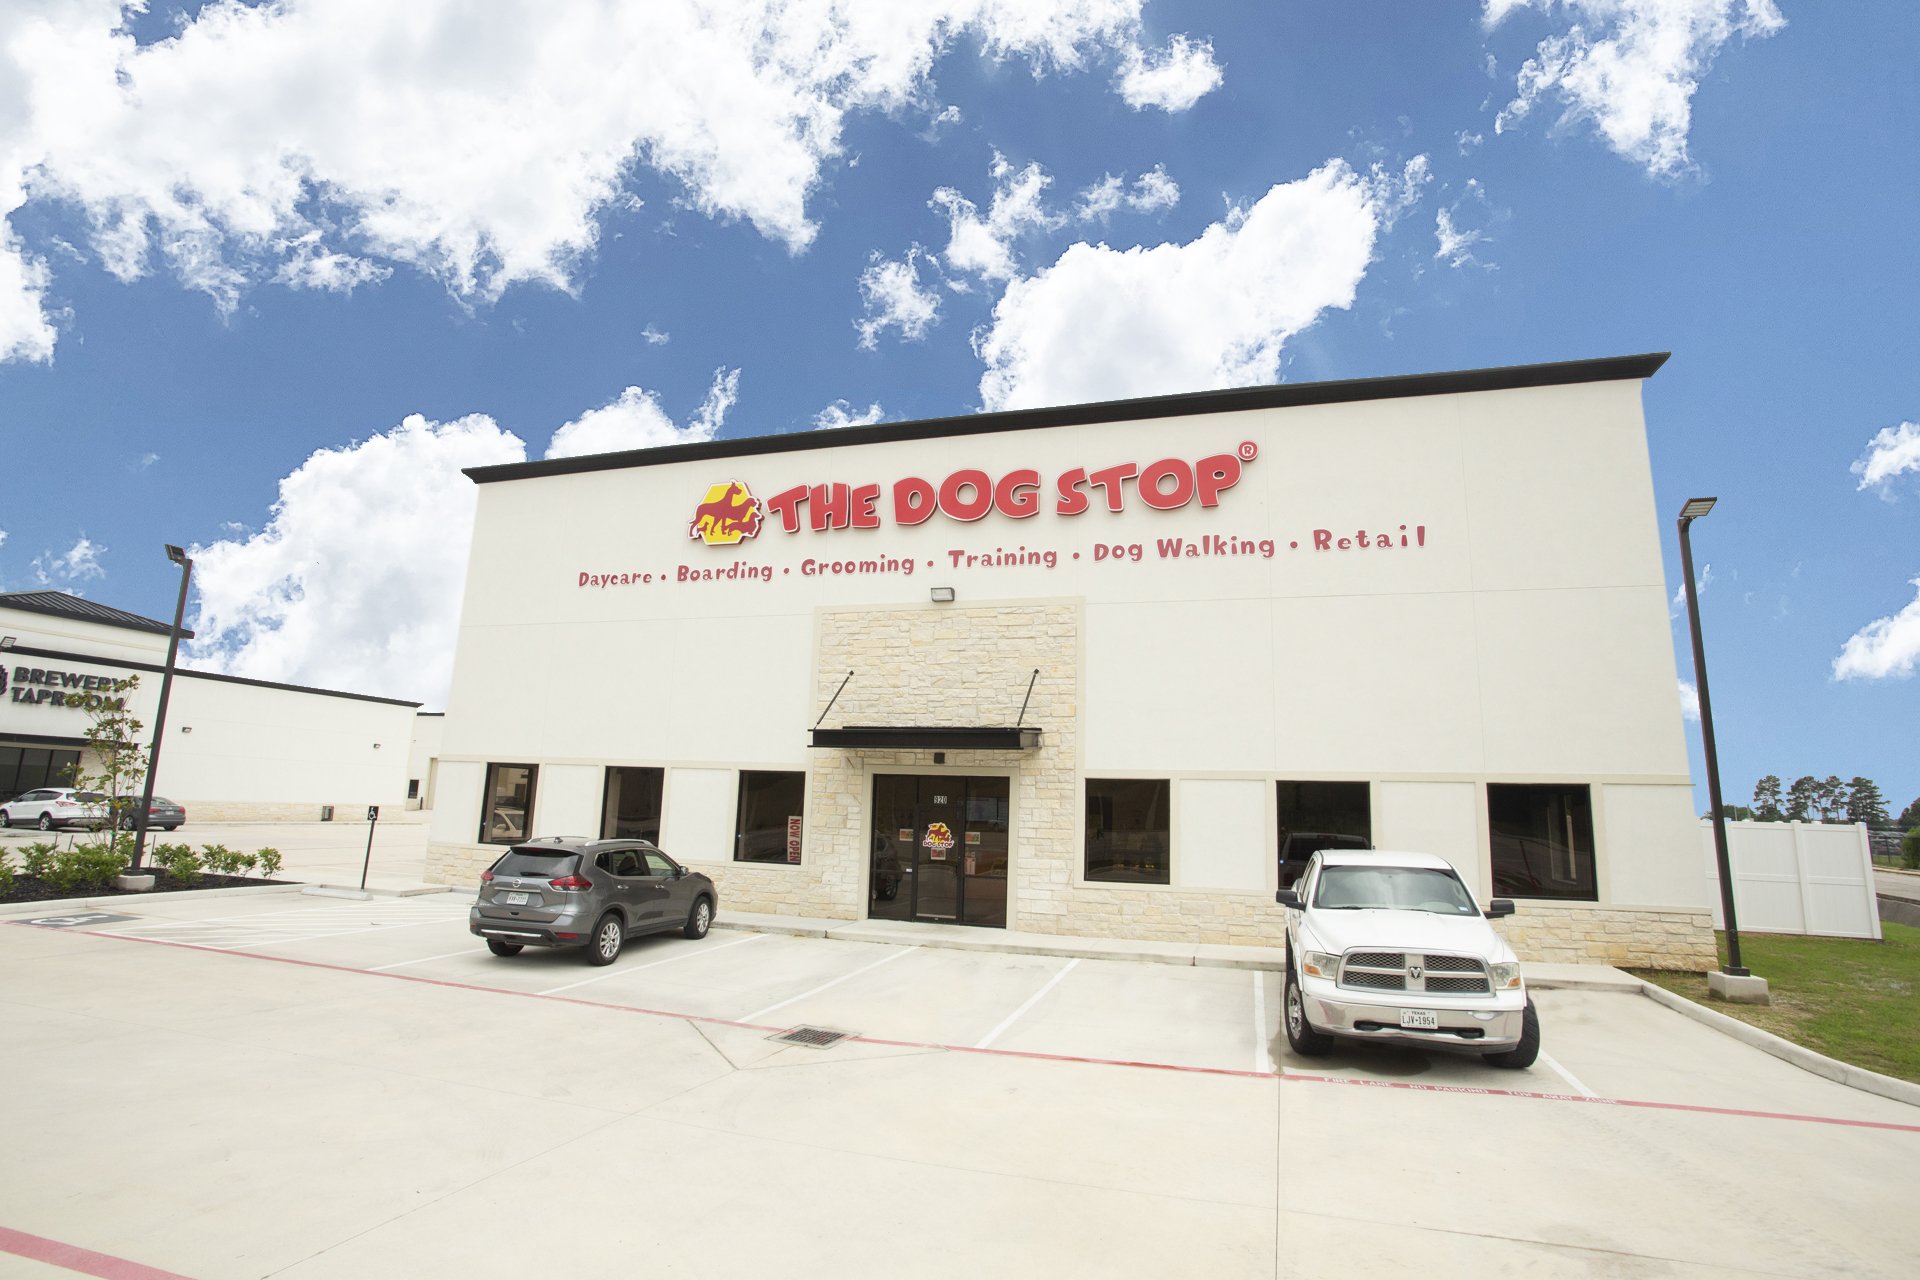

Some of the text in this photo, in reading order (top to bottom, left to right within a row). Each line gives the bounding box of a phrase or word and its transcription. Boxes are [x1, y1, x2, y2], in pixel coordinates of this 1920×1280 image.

[767, 482, 881, 534] THE
[893, 469, 1040, 526] DOG
[578, 524, 1427, 588] Daycare Boarding Grooming Training Dog Walking Retail
[933, 795, 947, 804] 920
[789, 818, 801, 862] NOW OPEN
